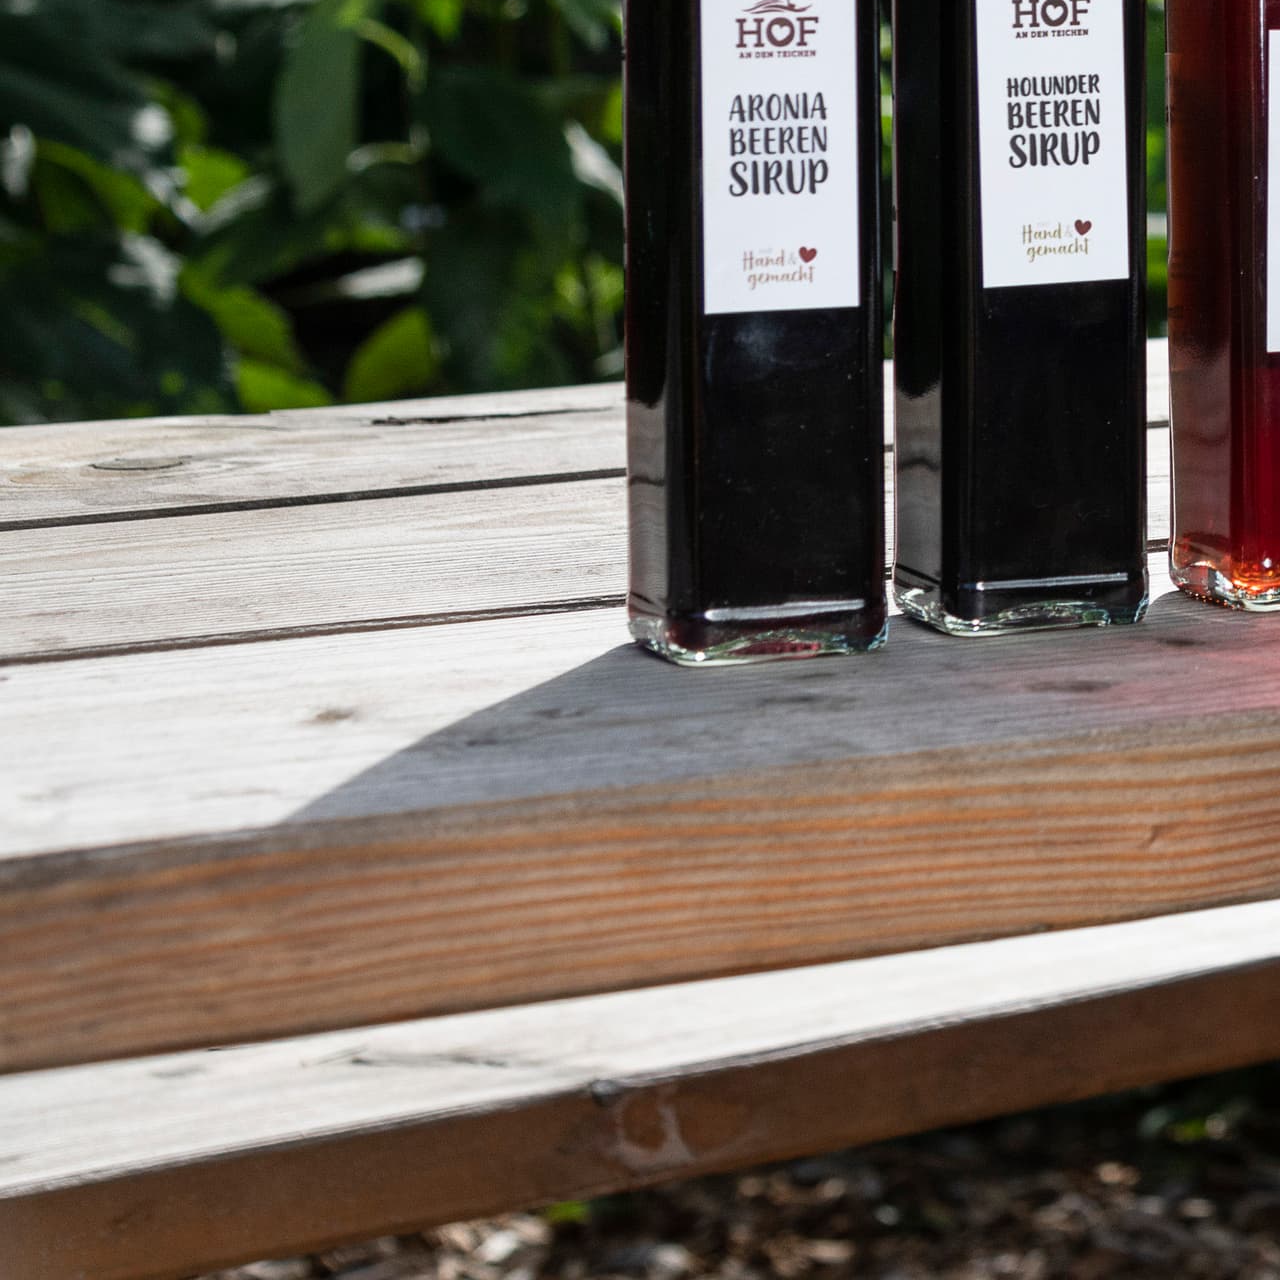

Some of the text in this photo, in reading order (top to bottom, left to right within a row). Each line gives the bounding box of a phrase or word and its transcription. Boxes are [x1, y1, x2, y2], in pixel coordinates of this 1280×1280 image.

[735, 16, 820, 49] HOF
[1015, 28, 1089, 39] AN DEN TEICHEN
[738, 49, 817, 60] AN DEN TEICHEN
[1006, 73, 1100, 97] HOLUNDER
[728, 92, 828, 123] ARONIA
[1006, 99, 1101, 130] BEEREN
[730, 126, 828, 156] BEEREN
[1008, 131, 1101, 168] SIRUP
[728, 159, 829, 197] SIRUP
[1021, 220, 1063, 247] Hand
[742, 248, 786, 272] Hand
[1025, 236, 1091, 263] gemacht
[747, 264, 814, 290] gemacht
